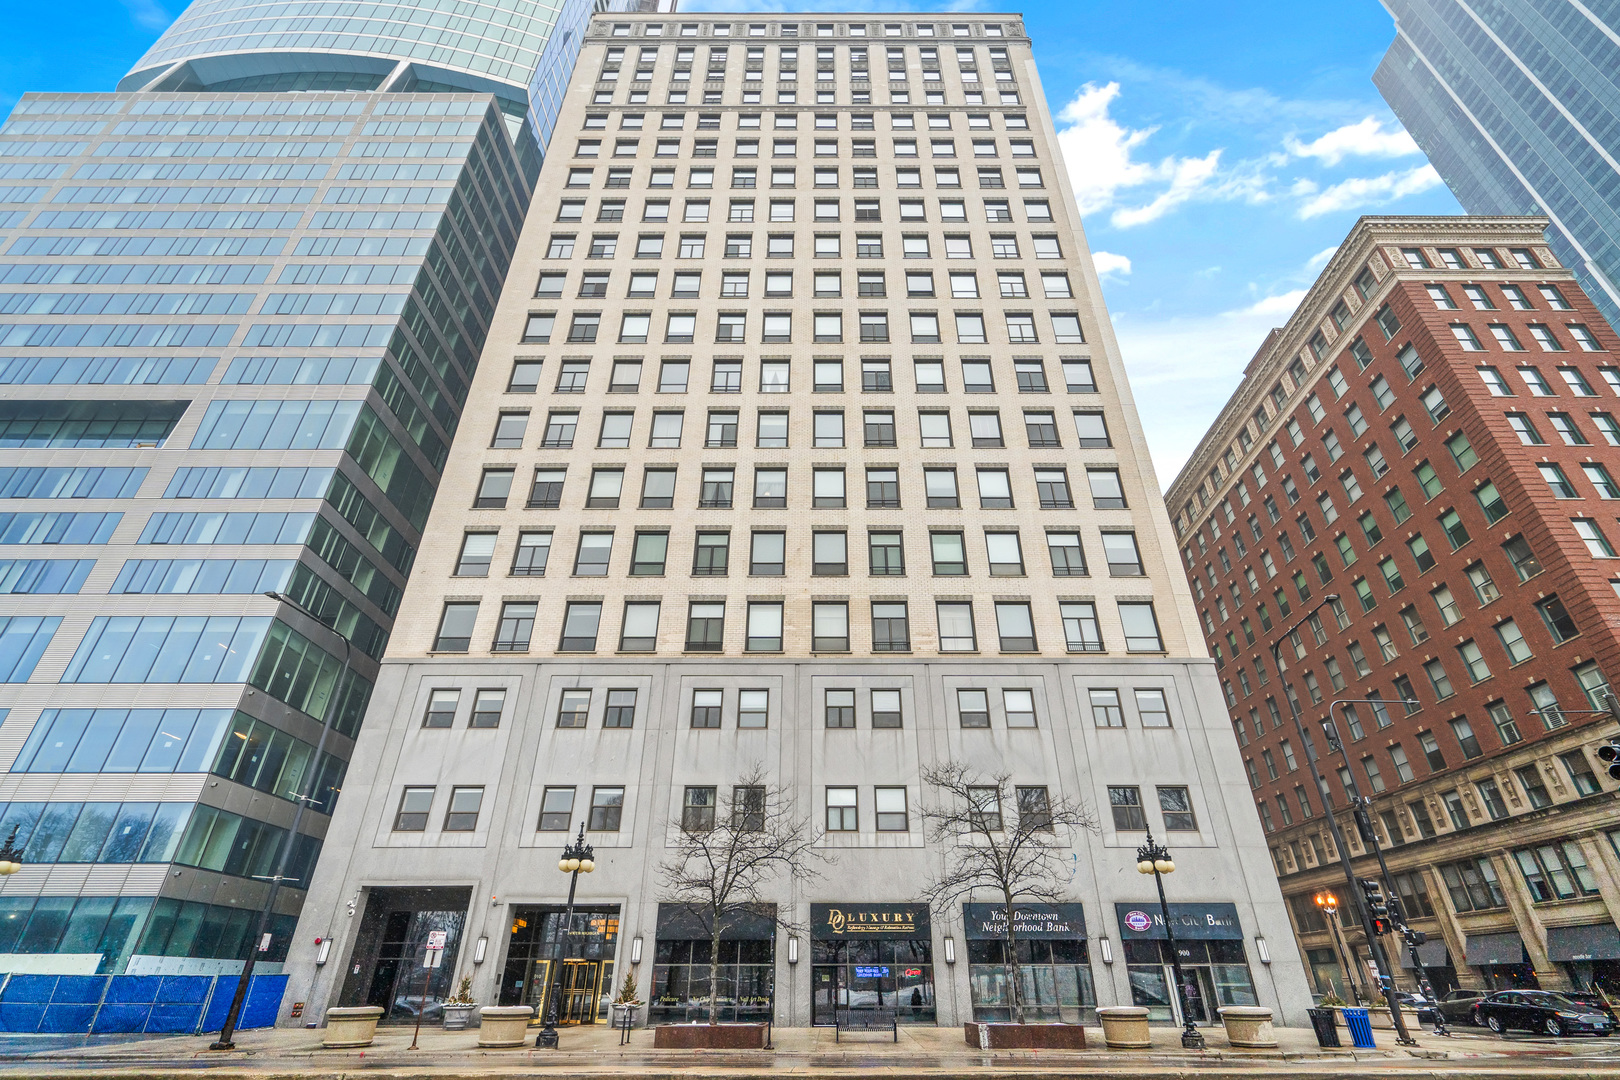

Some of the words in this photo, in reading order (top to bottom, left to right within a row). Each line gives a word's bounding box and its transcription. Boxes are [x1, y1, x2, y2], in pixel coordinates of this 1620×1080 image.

[847, 912, 914, 922] LUXURY
[1013, 910, 1058, 921] Downtown
[982, 921, 1043, 934] Neighorhood
[1046, 921, 1071, 932] Bank
[1178, 949, 1190, 957] 900
